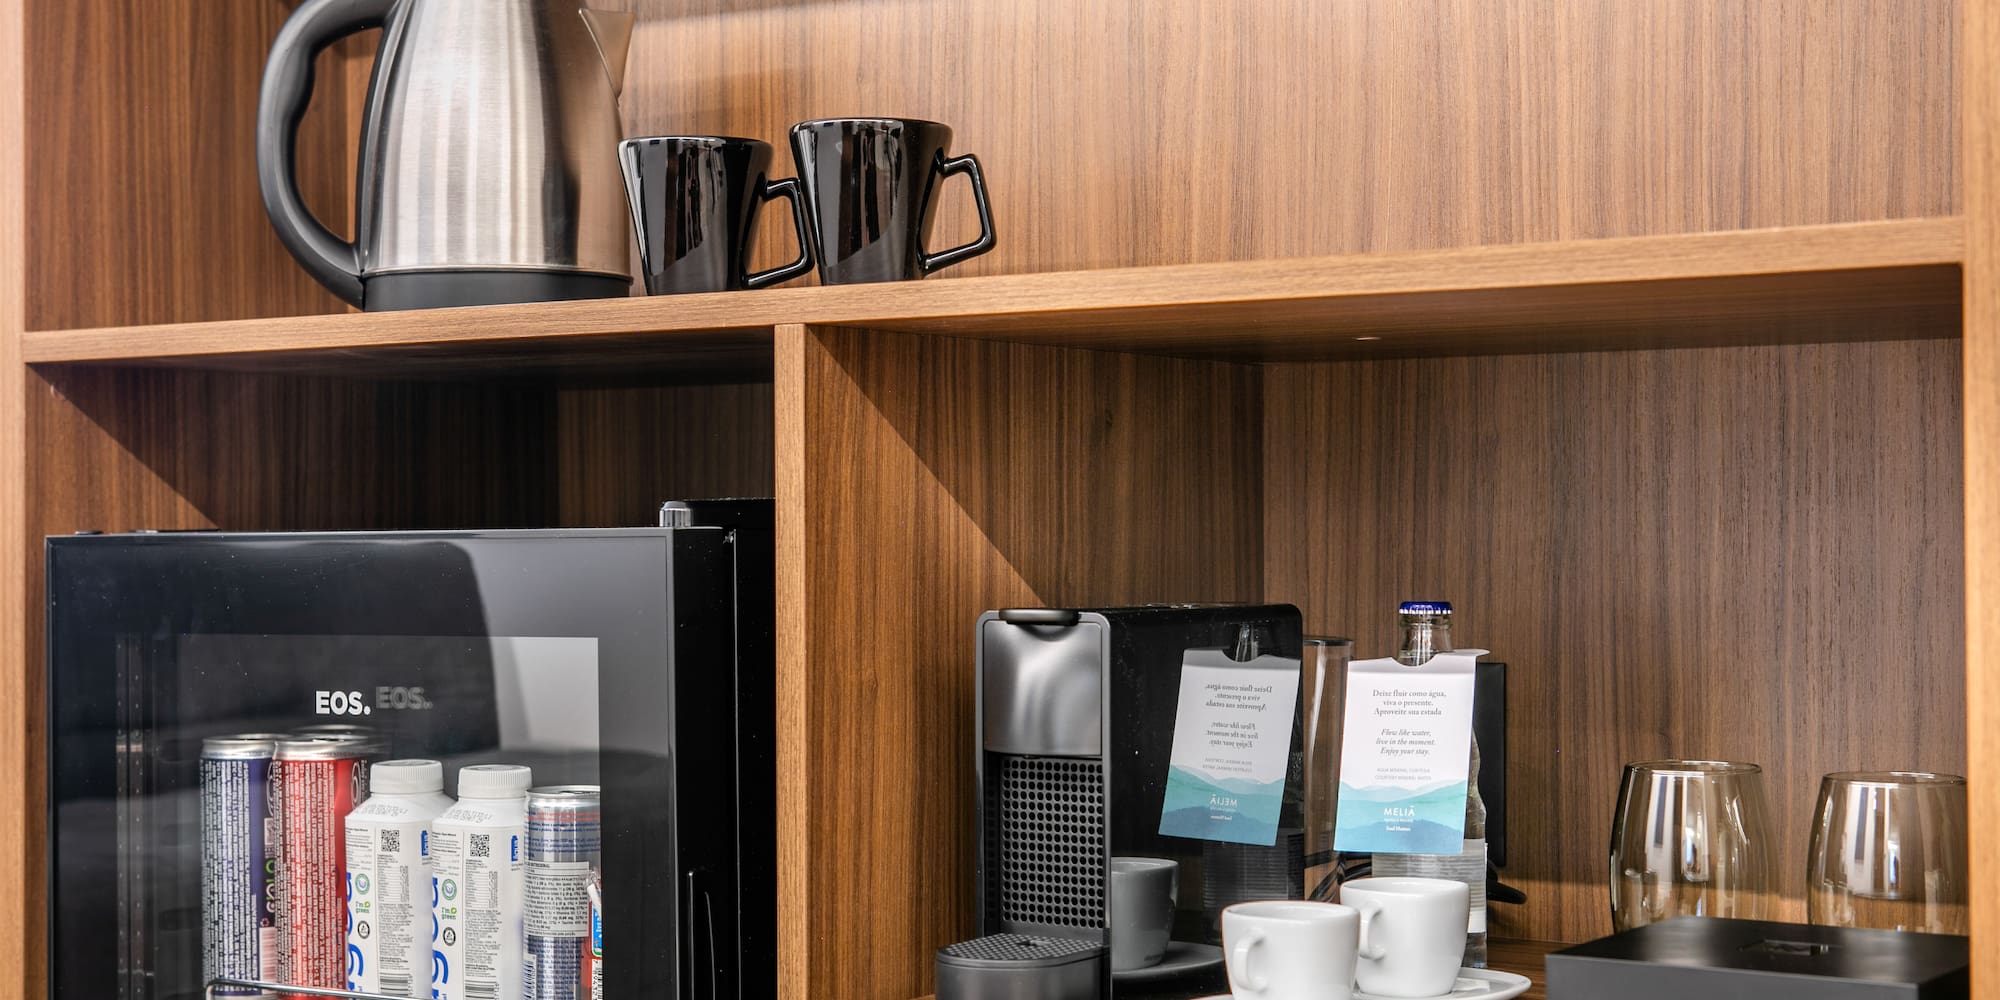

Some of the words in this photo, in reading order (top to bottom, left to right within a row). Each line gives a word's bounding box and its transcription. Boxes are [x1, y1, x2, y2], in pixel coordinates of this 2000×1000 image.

[1429, 690, 1446, 698] água,
[316, 691, 371, 715] EOS.
[1404, 700, 1434, 708] presente.
[1375, 708, 1406, 717] Aproveite
[1380, 748, 1399, 756] Enjoy
